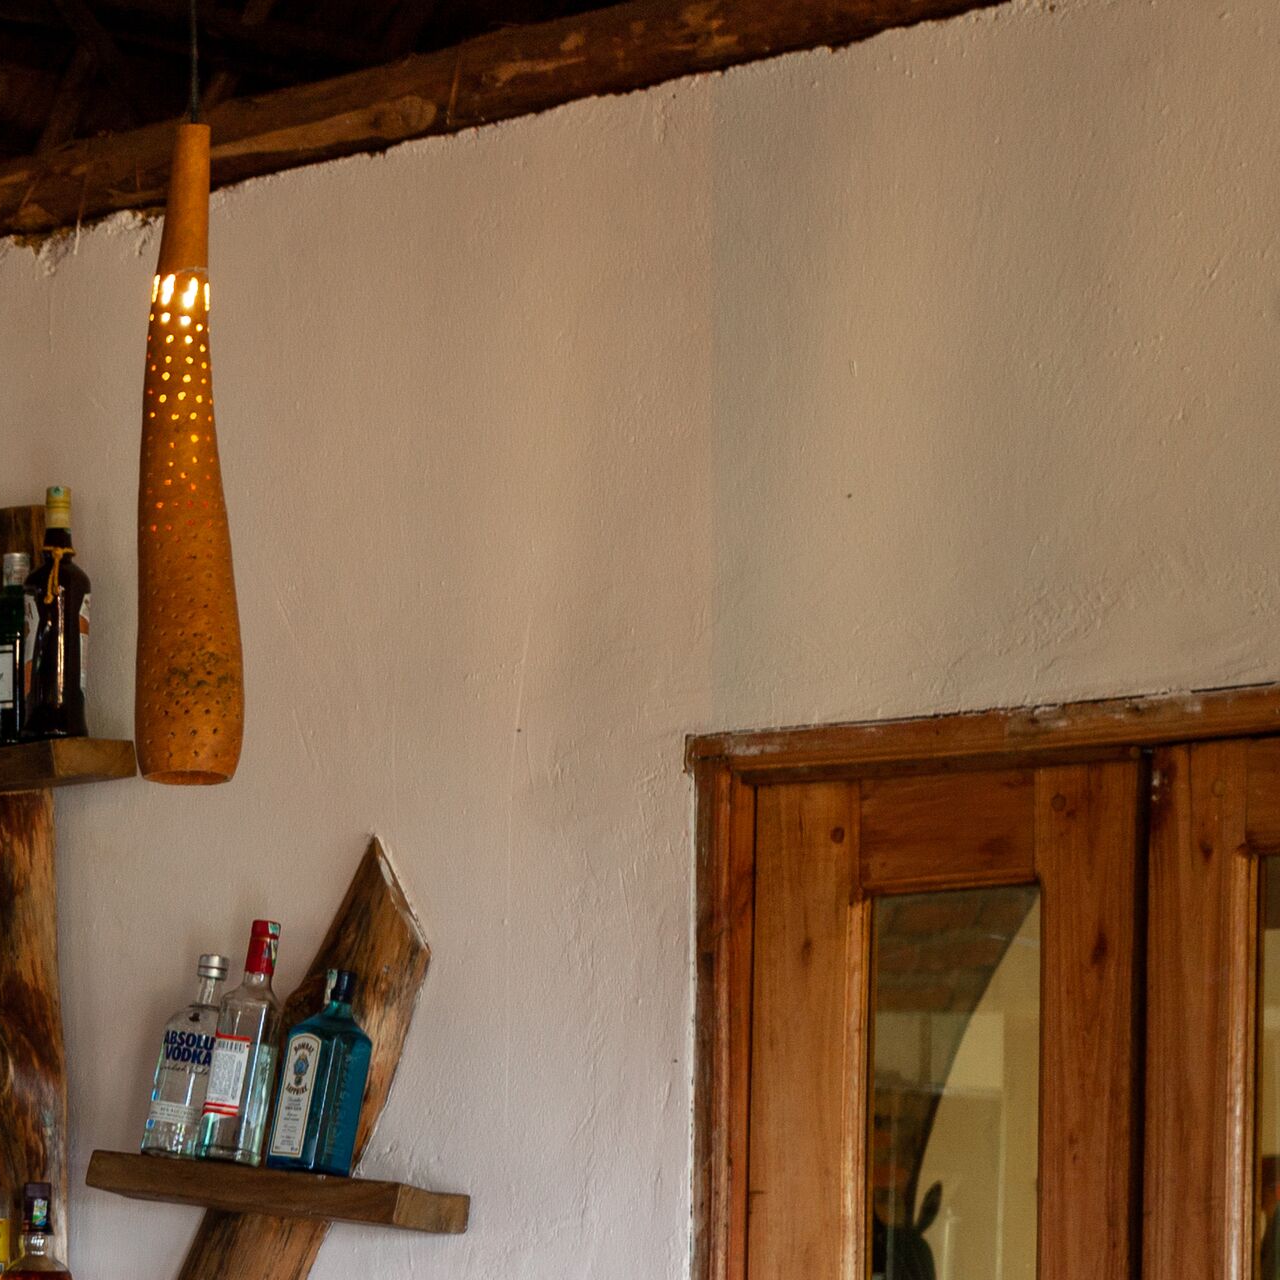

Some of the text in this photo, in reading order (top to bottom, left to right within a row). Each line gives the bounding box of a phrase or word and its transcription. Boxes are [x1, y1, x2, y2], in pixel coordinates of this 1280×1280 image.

[163, 1030, 216, 1051] ABSOLU
[293, 1042, 315, 1056] BOMBAY
[166, 1046, 213, 1067] VODKA
